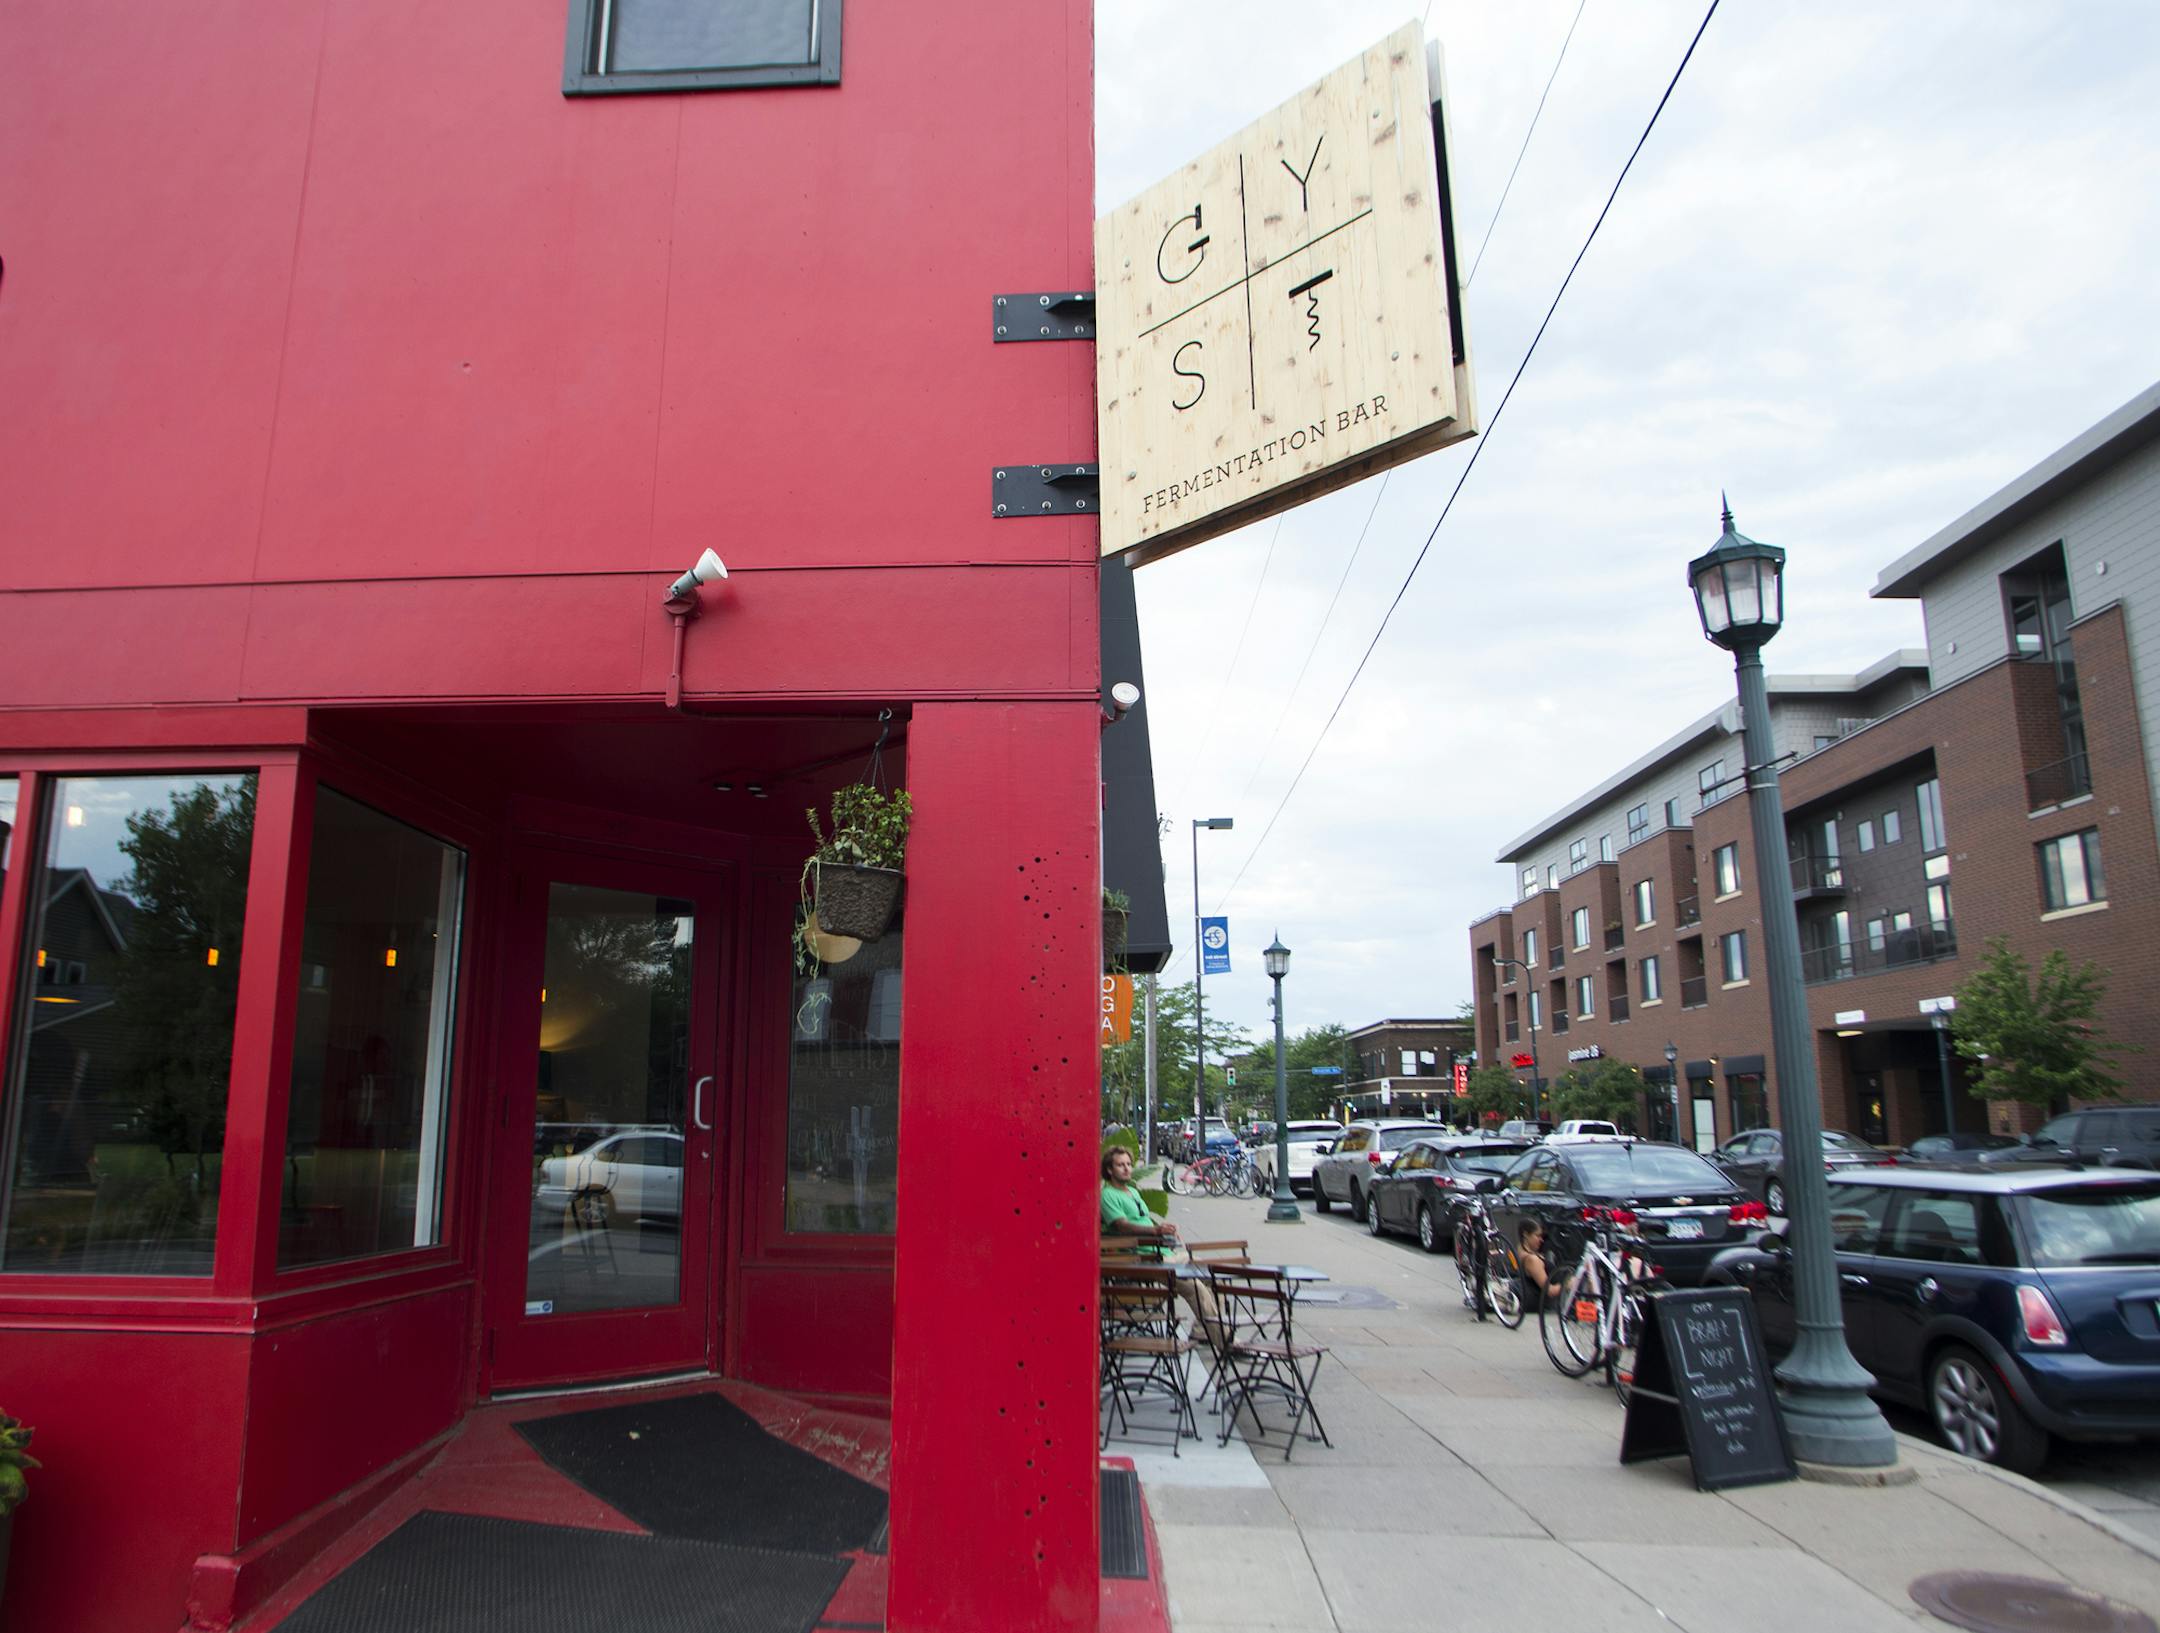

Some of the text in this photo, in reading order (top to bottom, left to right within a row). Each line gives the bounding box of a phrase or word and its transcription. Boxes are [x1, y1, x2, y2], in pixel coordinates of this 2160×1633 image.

[1143, 394, 1389, 514] FERMENTATION BAR
[1102, 977, 1115, 1032] OGA
